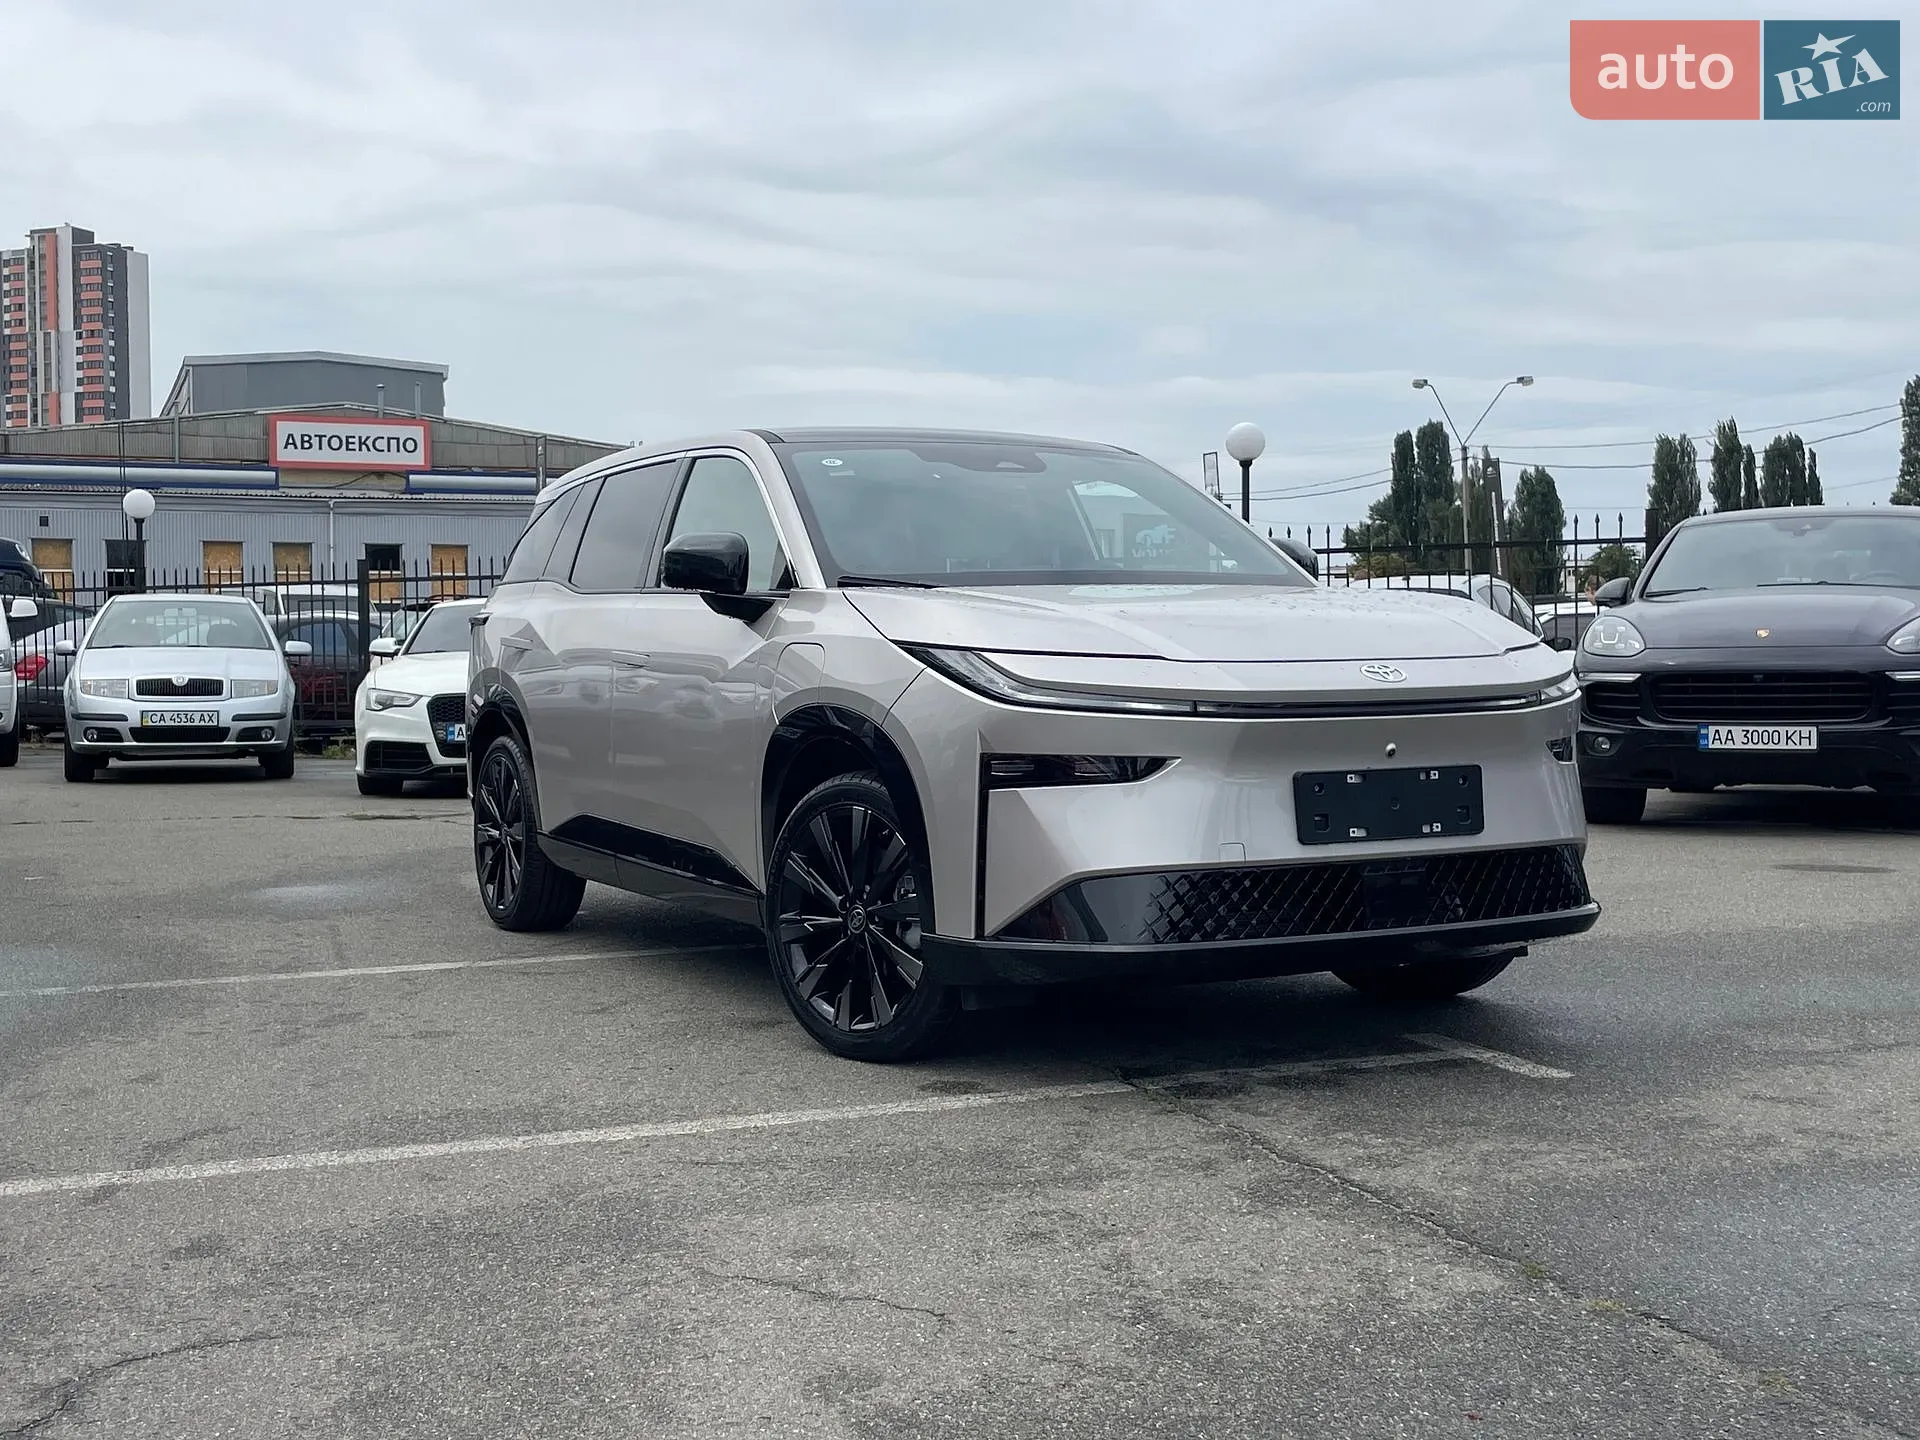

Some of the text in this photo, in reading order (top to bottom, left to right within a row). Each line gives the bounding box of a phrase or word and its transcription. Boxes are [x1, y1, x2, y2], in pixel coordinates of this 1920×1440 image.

[283, 433, 418, 454] АВТОЕКСПО
[149, 713, 215, 724] CA 4536 AX
[1711, 729, 1812, 746] AA 3000 KH
